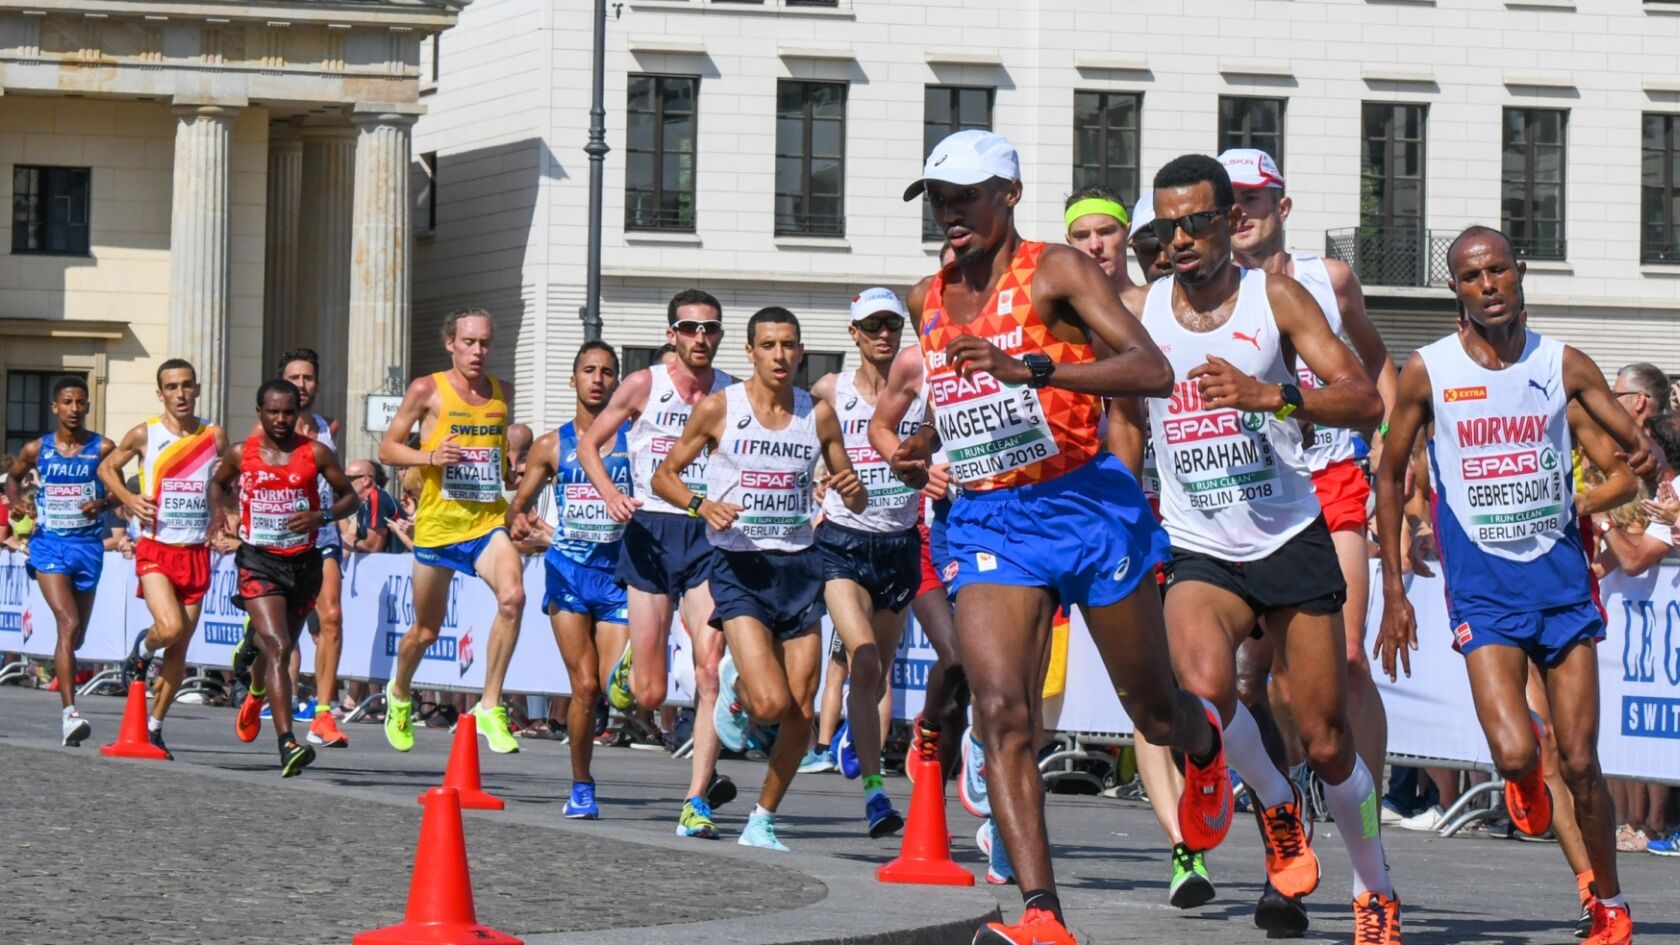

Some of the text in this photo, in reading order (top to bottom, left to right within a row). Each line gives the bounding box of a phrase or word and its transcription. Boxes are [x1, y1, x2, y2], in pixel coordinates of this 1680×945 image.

[933, 373, 997, 402] SPAR
[1457, 389, 1486, 399] EXTRA
[939, 398, 1023, 442] NAGEEYE
[450, 424, 503, 436] SWEDEN
[1166, 416, 1239, 441] SPAR
[1456, 414, 1548, 449] NORWAY
[1313, 432, 1333, 446] 018
[460, 449, 490, 461] PAR
[749, 439, 813, 461] FRANCE
[965, 445, 986, 458] RUN
[986, 437, 1019, 454] CLEAN
[954, 443, 1047, 480] BERLIN 2018
[1173, 440, 1259, 476] ABRAHAM
[1463, 453, 1538, 478] SPAR
[46, 463, 90, 477] ITALIA
[446, 465, 494, 481] EKVALL
[163, 480, 204, 493] SPAR
[742, 472, 795, 488] SPAR
[1196, 479, 1217, 491] RUN
[1219, 474, 1252, 488] CLEAN
[45, 485, 81, 496] SPAR
[447, 490, 478, 499] BERLIN
[1190, 483, 1273, 508] BERLIN 2018
[1467, 477, 1551, 508] GEBRETSADIK
[165, 496, 208, 510] ESPAÑA
[253, 501, 293, 513] SPAR
[742, 492, 800, 512] CHAHDI
[166, 519, 192, 527] BERLIN
[253, 516, 289, 531] GIRMALEG
[1495, 513, 1515, 523] RUN
[1516, 509, 1543, 521] CLEAN
[570, 531, 601, 541] BERLIN
[743, 525, 780, 537] BERLIN
[1479, 517, 1558, 541] BERLIN 2018
[386, 574, 402, 625] LE
[1621, 599, 1657, 683] LE
[1628, 701, 1680, 733] SWIT
